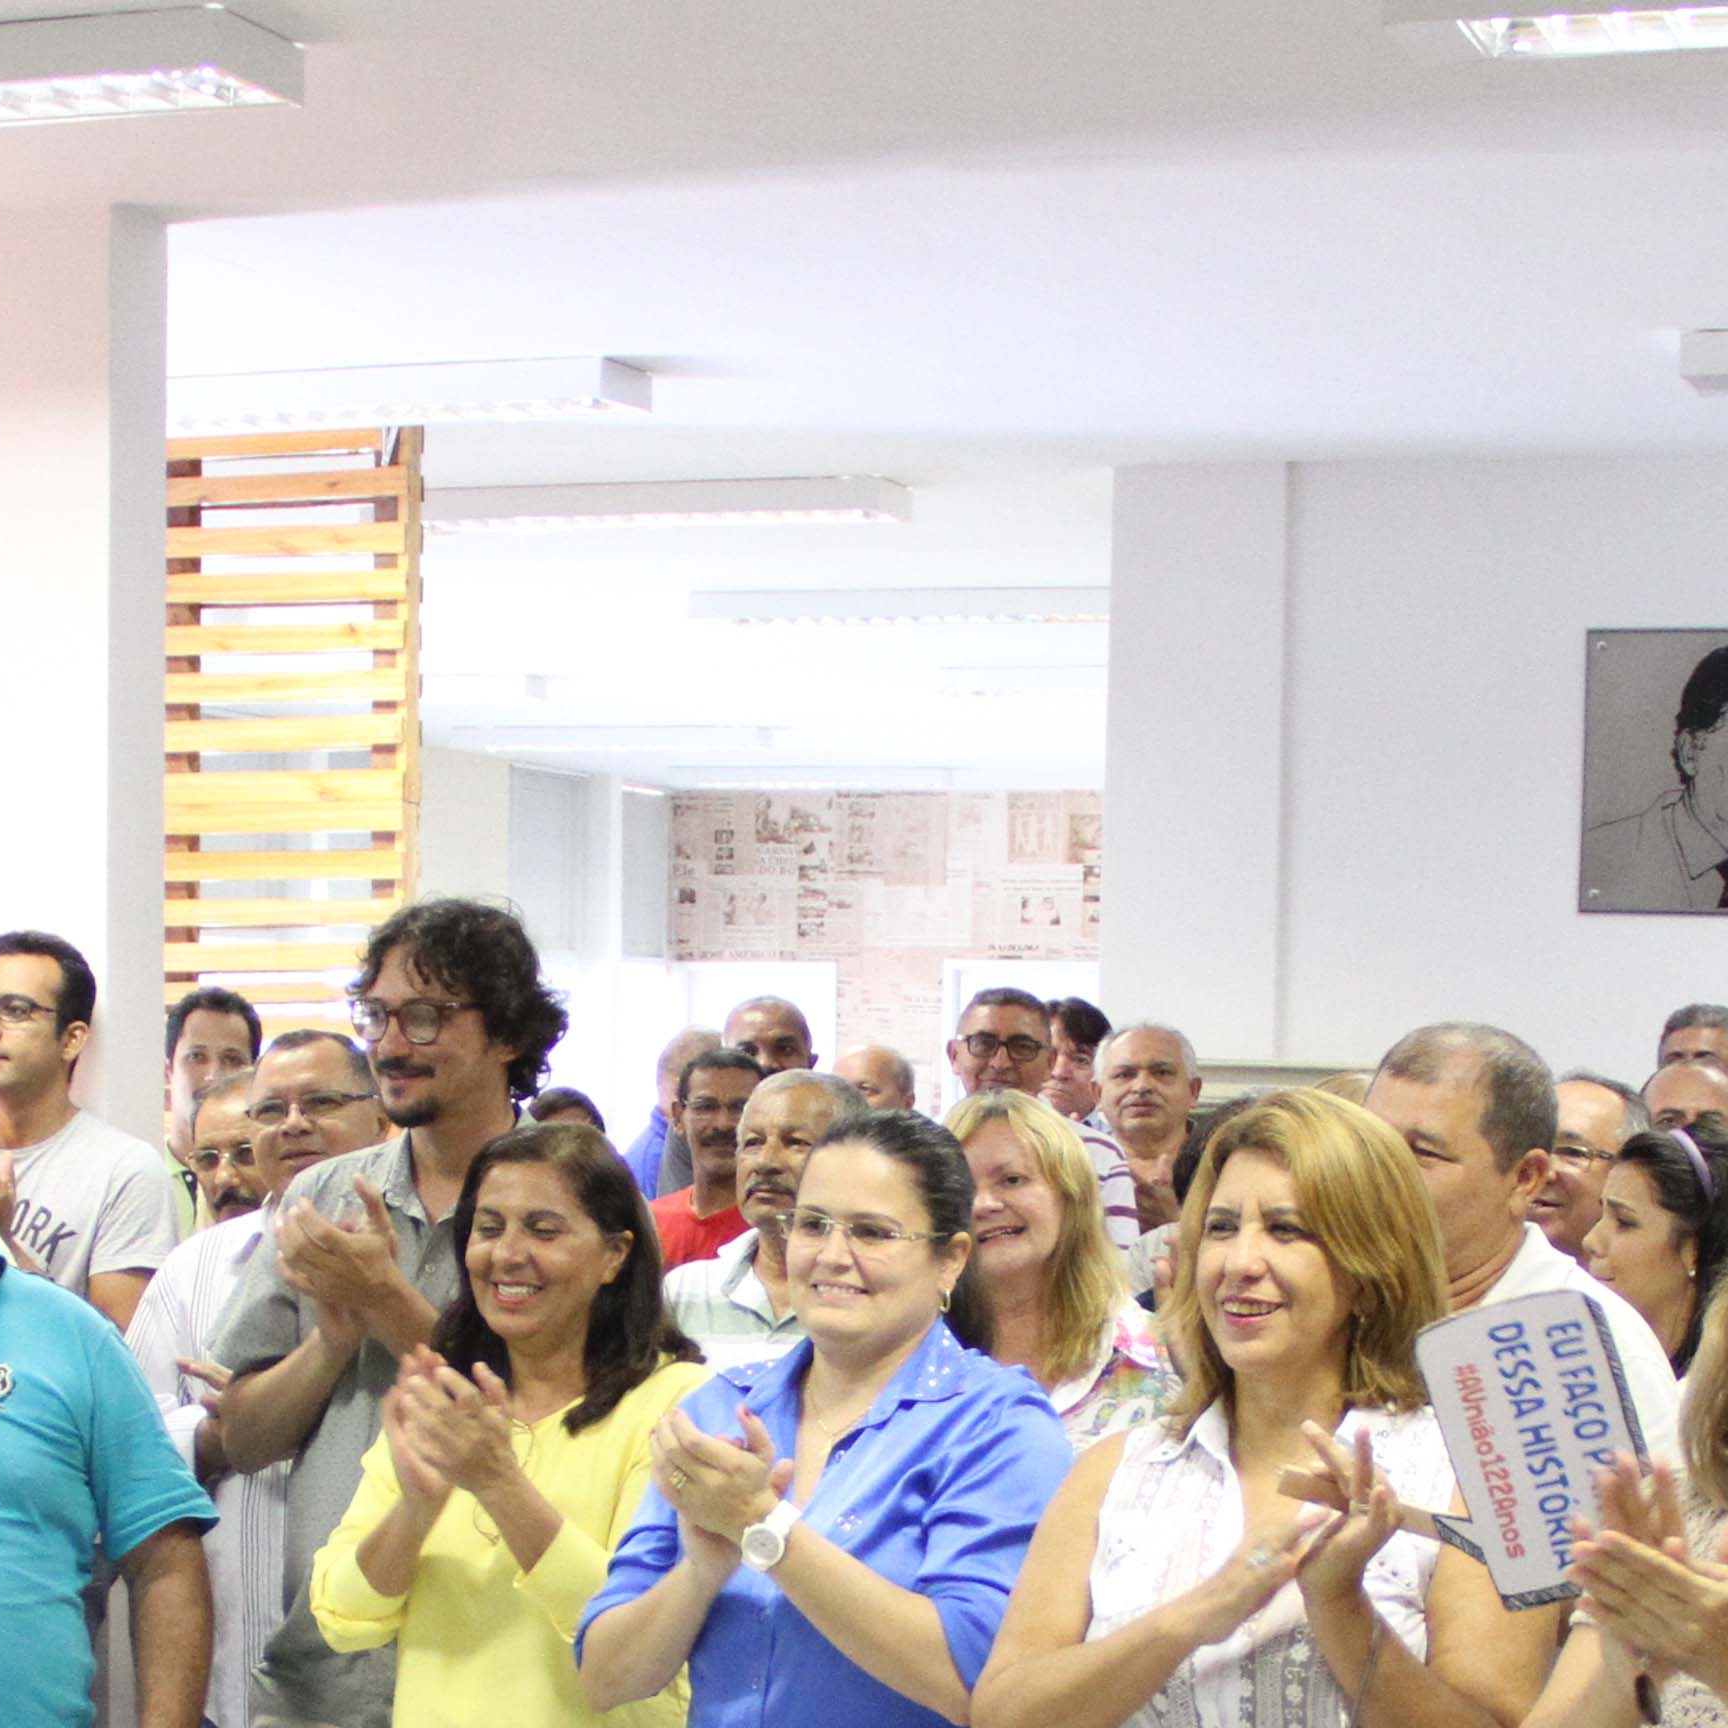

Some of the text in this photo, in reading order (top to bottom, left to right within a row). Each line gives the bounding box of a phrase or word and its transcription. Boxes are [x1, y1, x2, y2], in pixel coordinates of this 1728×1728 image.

[10, 1198, 78, 1264] ORK
[1487, 1319, 1546, 1420] DESSA
[1545, 1320, 1588, 1360] EU
[1557, 1365, 1610, 1440] FAÇO
